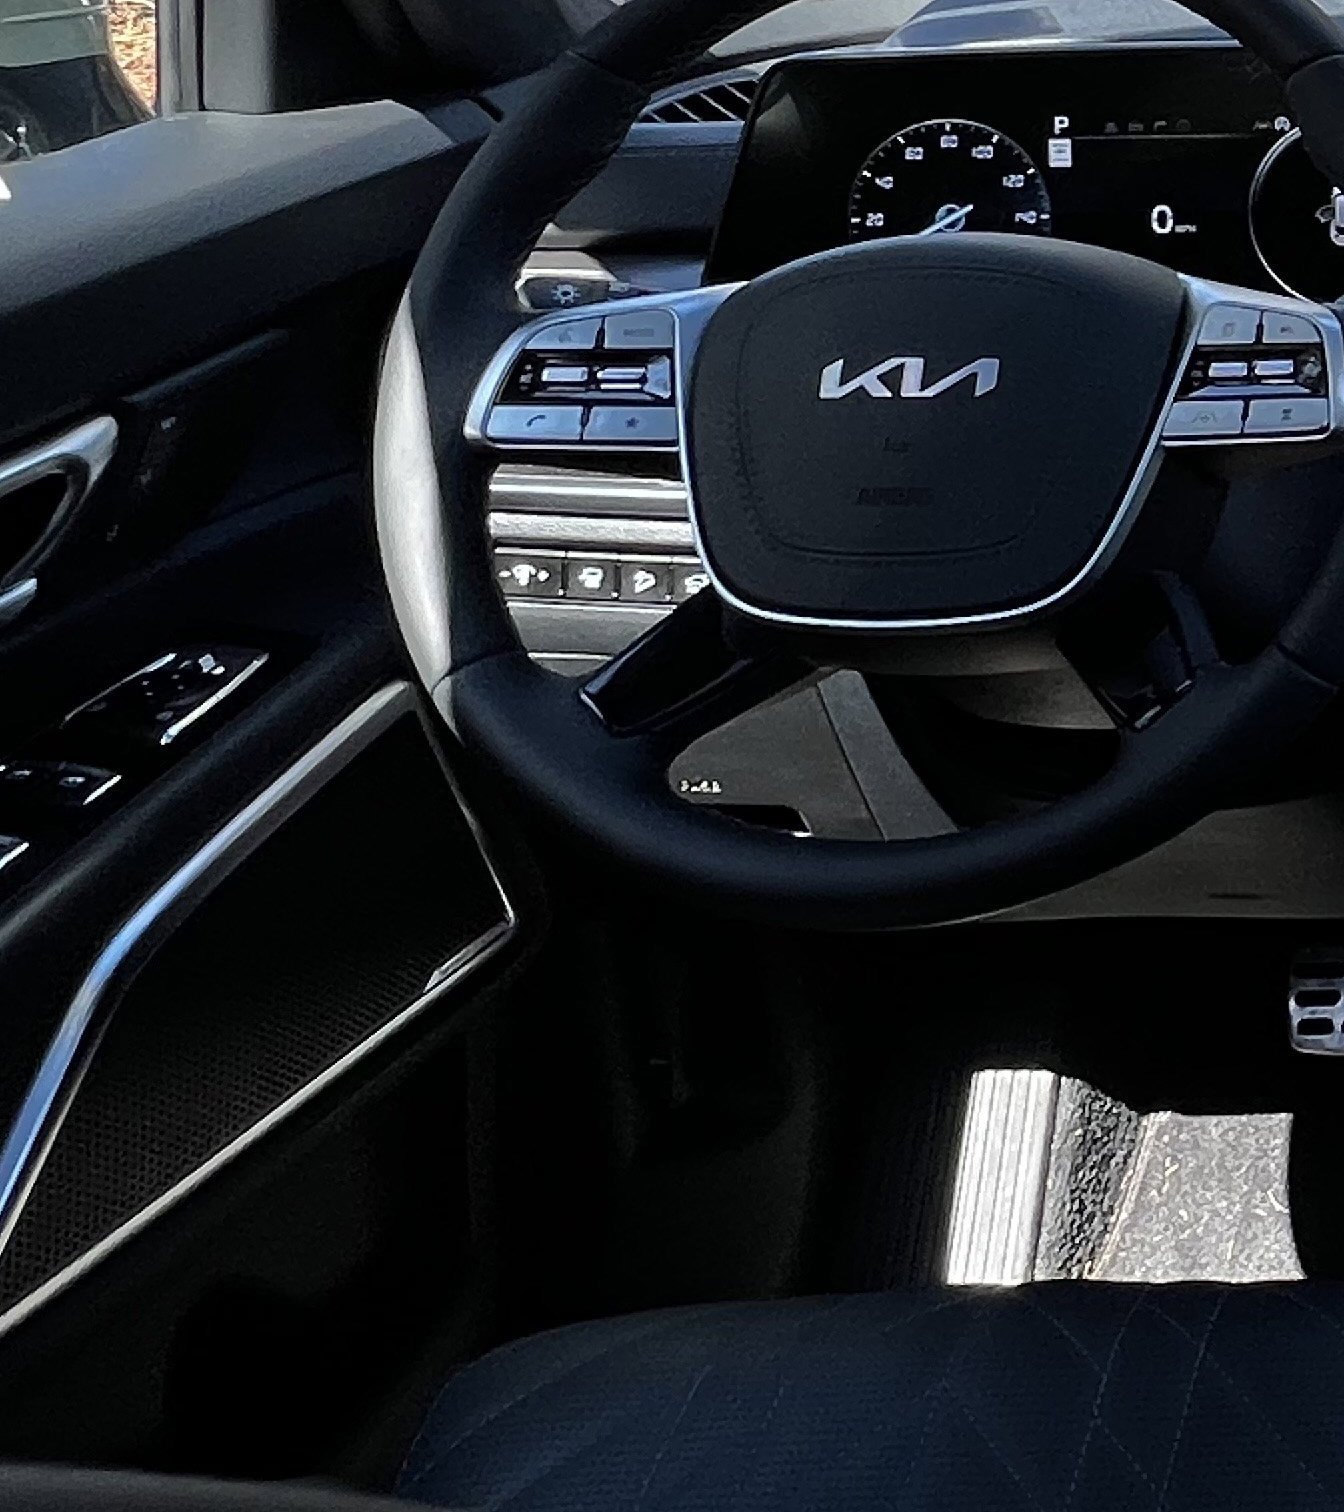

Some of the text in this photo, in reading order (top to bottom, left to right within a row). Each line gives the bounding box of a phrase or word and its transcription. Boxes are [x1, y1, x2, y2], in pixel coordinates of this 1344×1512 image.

[1053, 115, 1070, 134] P
[1150, 204, 1174, 235] 0
[818, 354, 1001, 401] KIA
